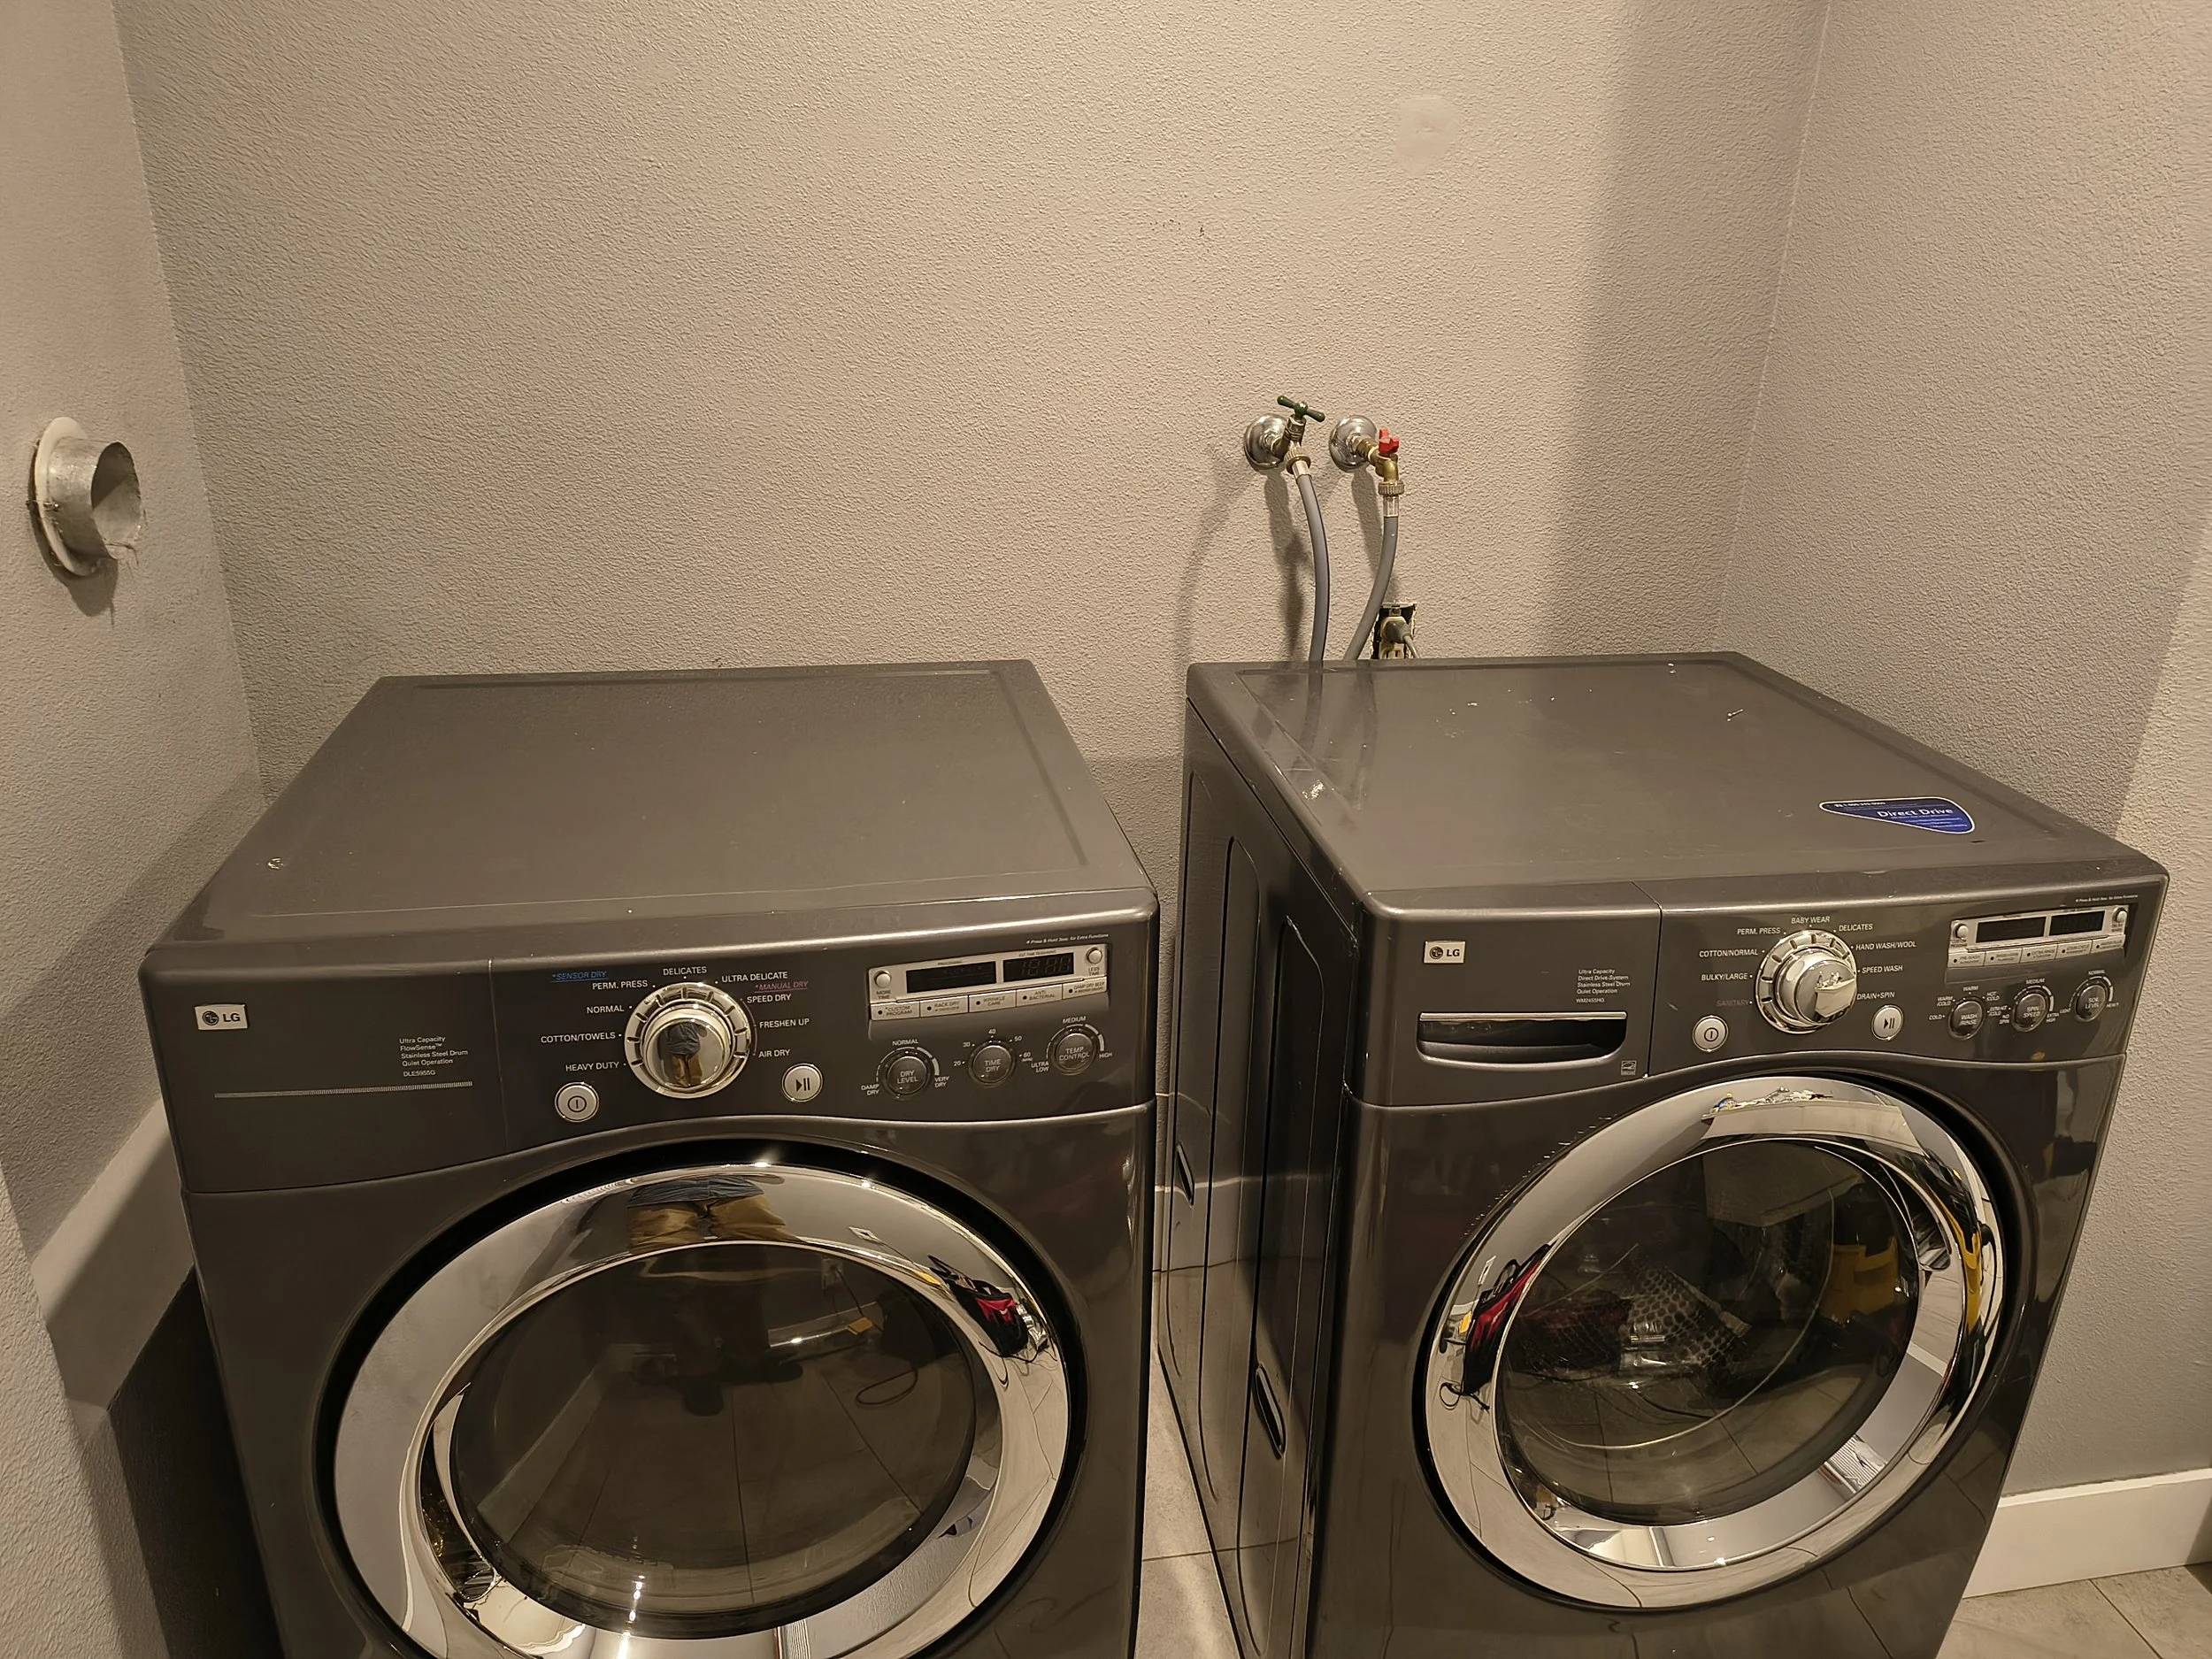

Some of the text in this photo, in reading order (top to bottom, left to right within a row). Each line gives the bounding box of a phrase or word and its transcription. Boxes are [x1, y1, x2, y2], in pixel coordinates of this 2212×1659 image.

[1839, 923, 1873, 932] DELICATES
[1876, 941, 1916, 949] WASH/WOOL
[1446, 949, 1460, 957] LG
[1699, 949, 1758, 957] COTTON/NORMAL
[663, 966, 707, 976] DELICATES
[721, 972, 788, 983] ULTRA DELICATE
[592, 979, 649, 990] PERM. PRESS
[747, 995, 773, 1003] SPEED
[587, 1005, 625, 1014] NORMAL
[222, 1012, 241, 1023] LG
[759, 1018, 810, 1029] FRESHEN UP
[541, 1032, 616, 1043] COTTON/TOWELS
[773, 1048, 791, 1057] DRY
[1059, 1052, 1090, 1061] CONTROL
[565, 1061, 619, 1071] HEAVY DUTY
